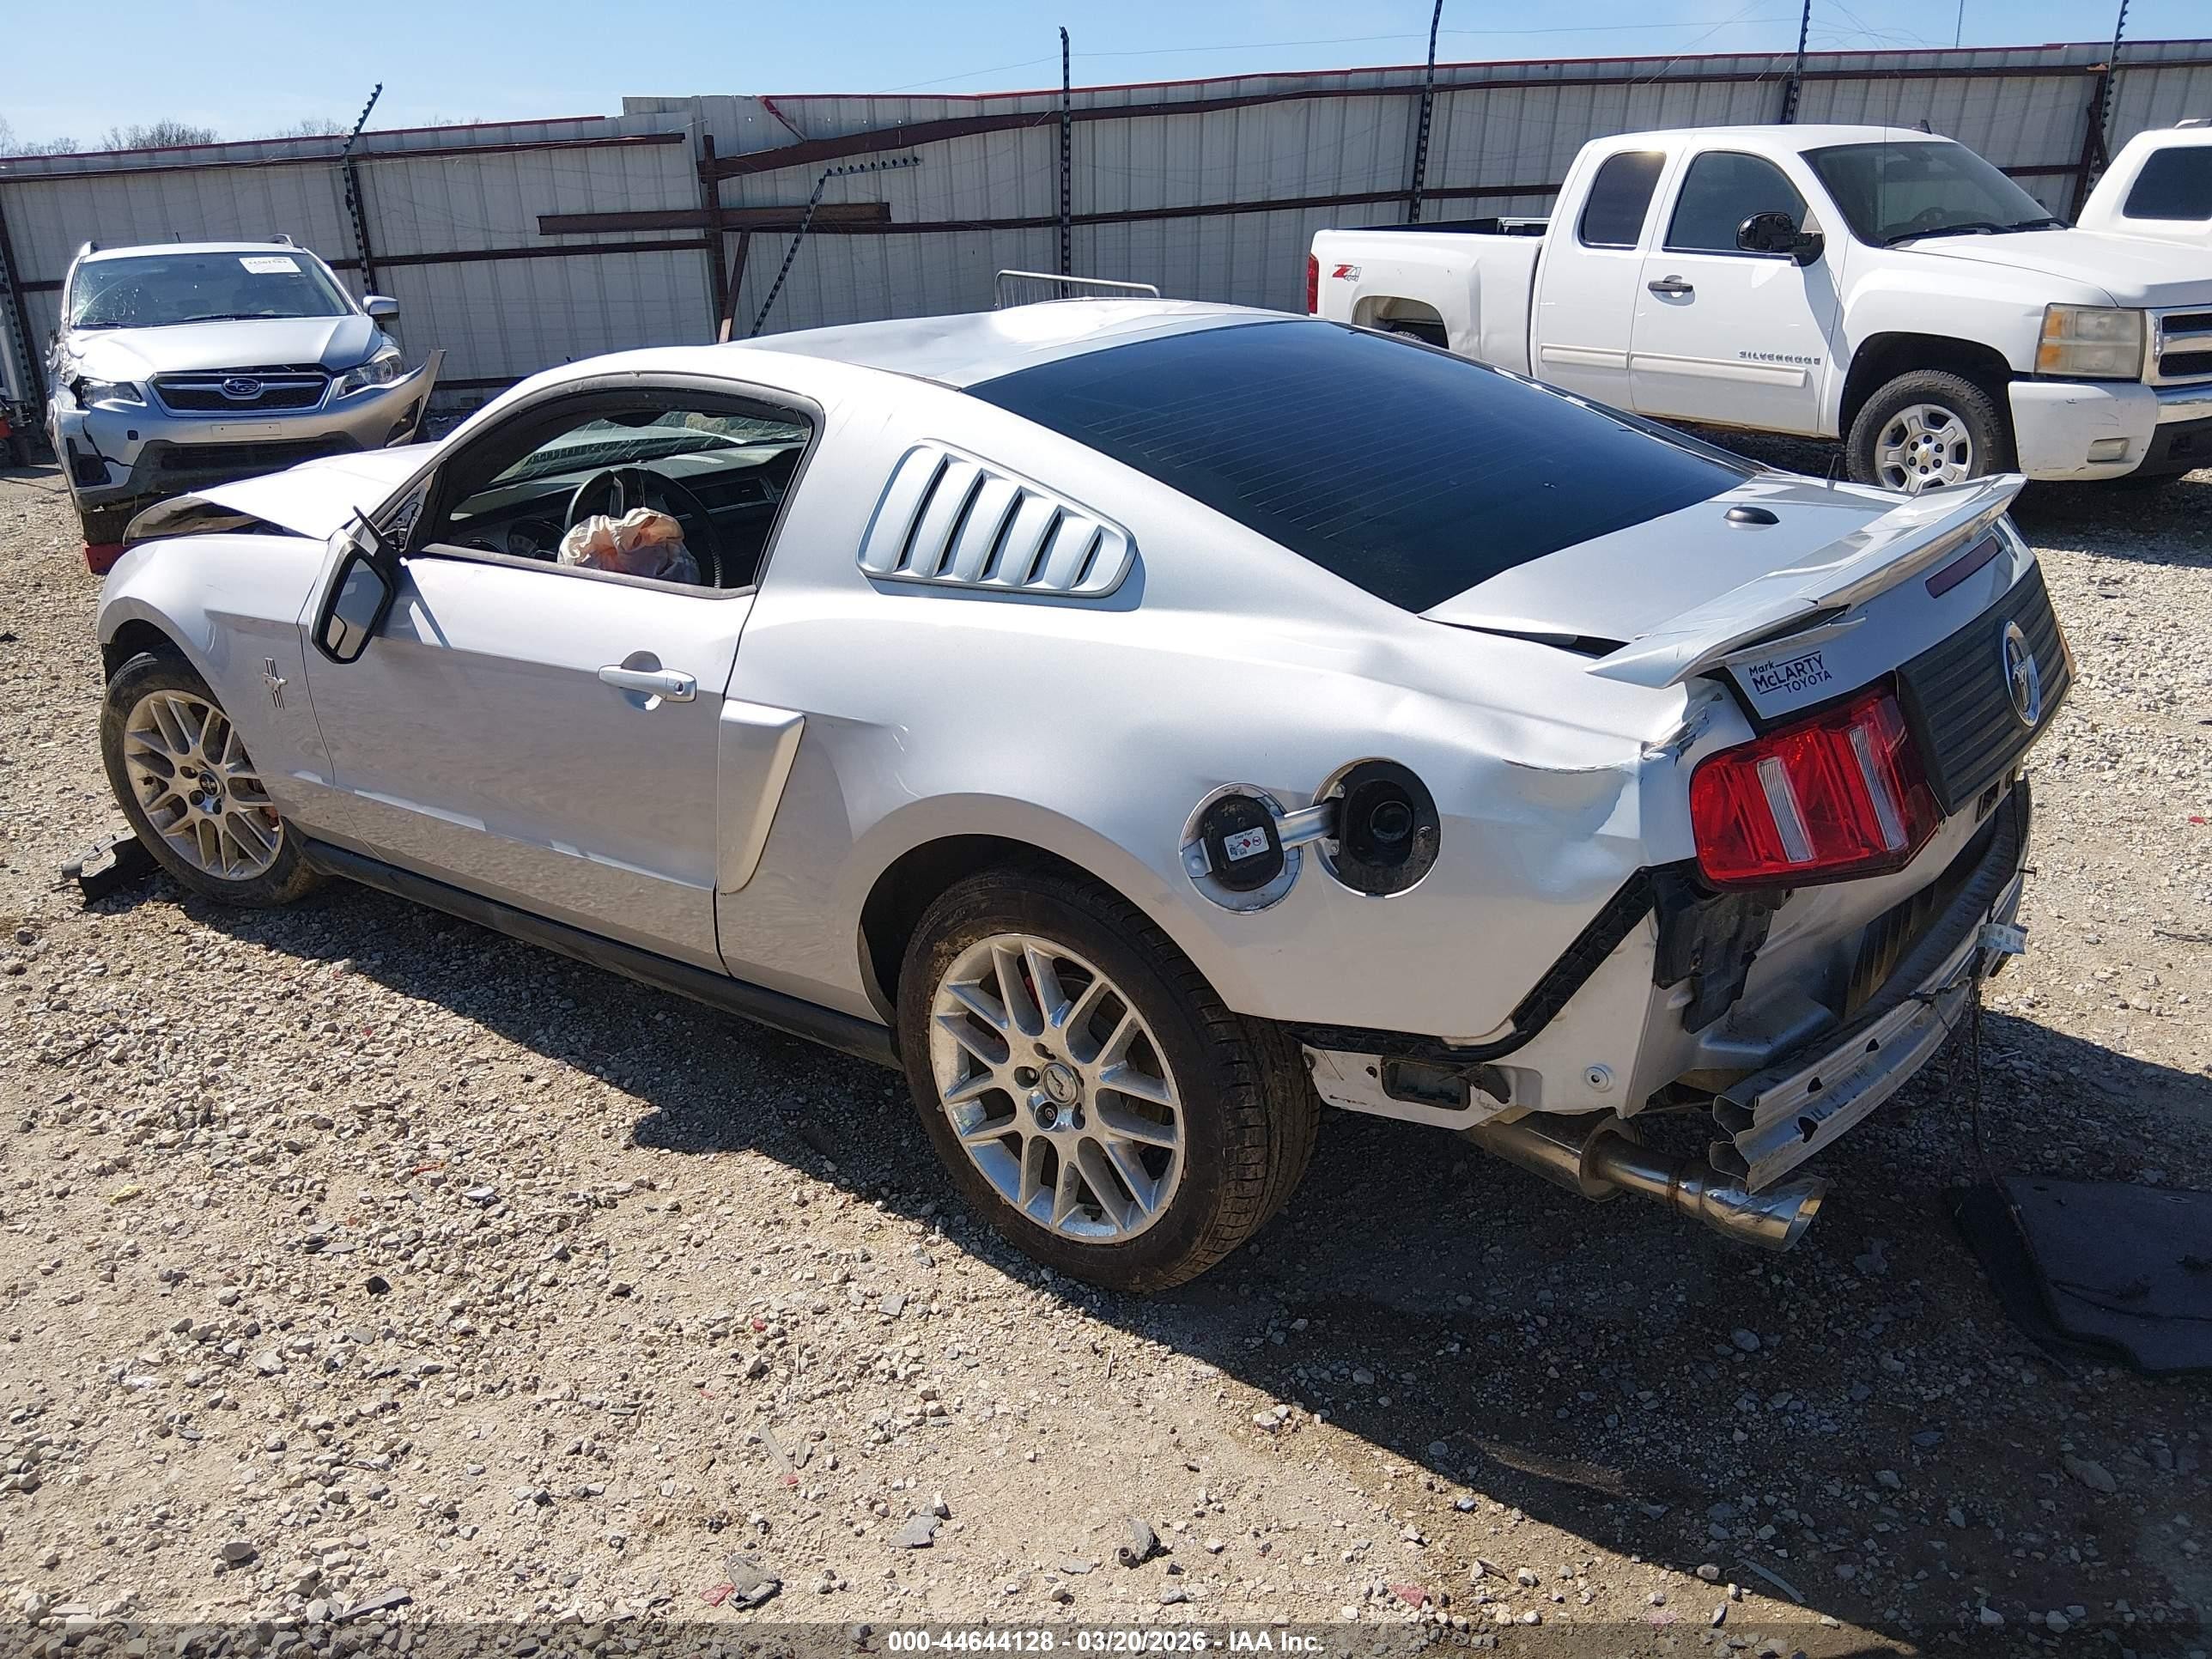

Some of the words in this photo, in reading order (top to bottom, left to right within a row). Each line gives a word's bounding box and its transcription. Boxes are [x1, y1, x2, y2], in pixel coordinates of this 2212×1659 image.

[1332, 264, 1361, 277] Z71
[1748, 660, 1776, 677] Mark
[1752, 653, 1825, 692] McLARTY
[1784, 670, 1833, 694] TOYOTA
